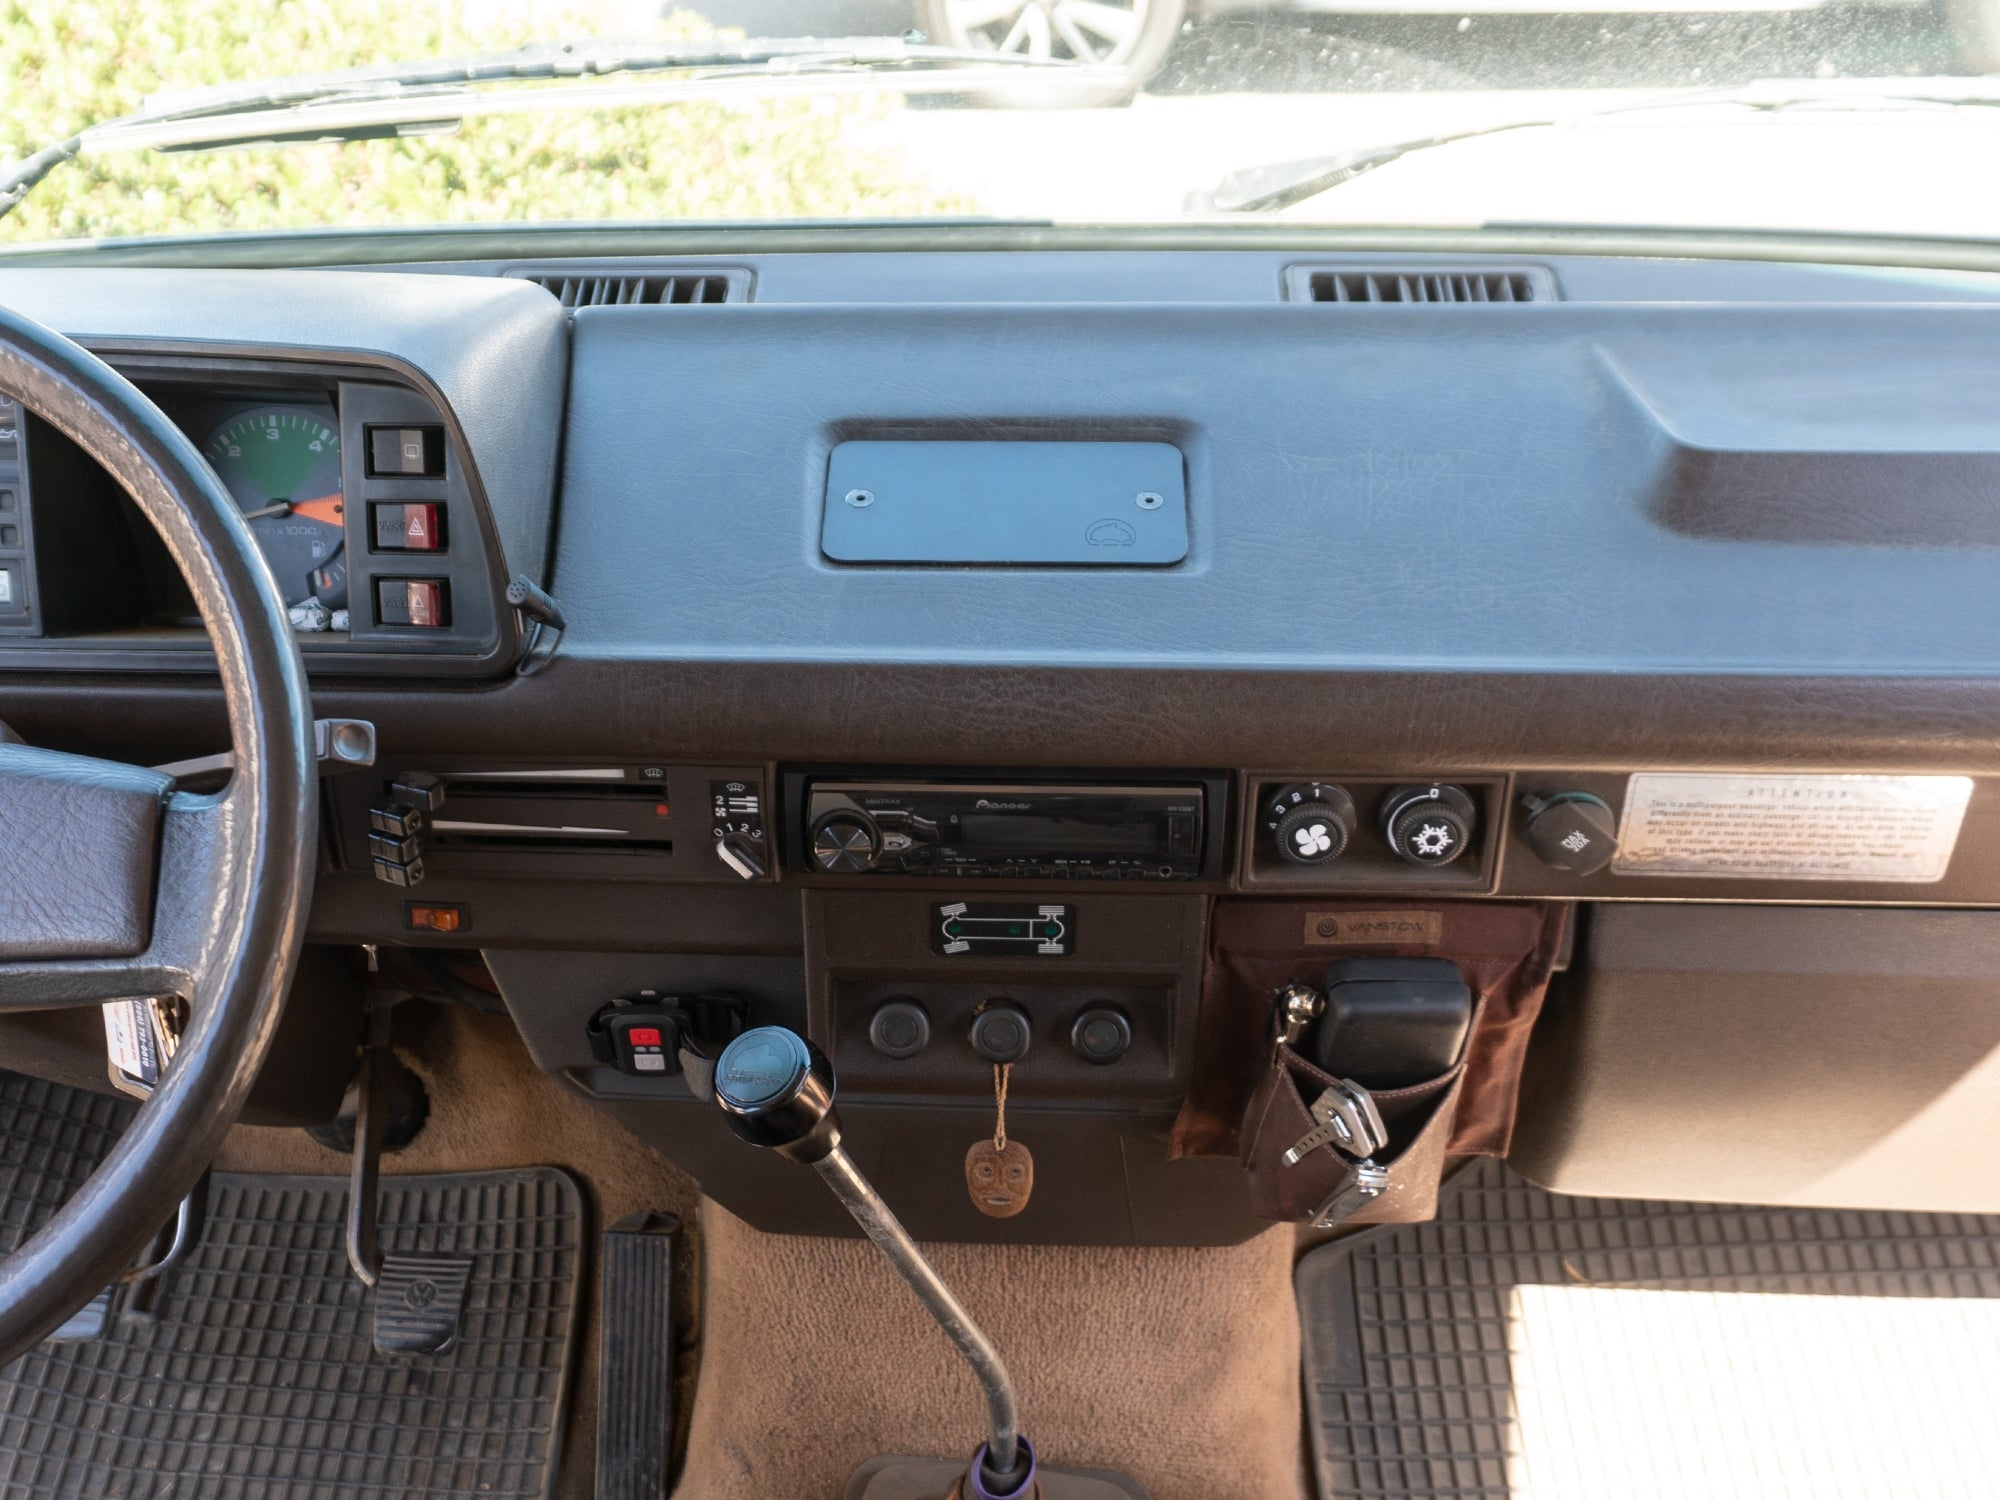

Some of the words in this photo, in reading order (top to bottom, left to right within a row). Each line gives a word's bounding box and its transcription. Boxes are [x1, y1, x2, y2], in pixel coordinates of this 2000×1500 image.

[266, 429, 280, 440] 3
[228, 446, 242, 458] 2
[308, 440, 323, 453] 4
[1747, 787, 1849, 799] ATTENTION
[716, 795, 725, 805] 2
[976, 799, 1032, 810] Pioneer
[1275, 804, 1286, 815] 3
[1291, 792, 1302, 803] 2
[1313, 788, 1321, 798] 1
[1652, 799, 1666, 808] This
[1650, 809, 1691, 818] differently
[713, 828, 724, 838] 0
[726, 822, 734, 832] 1
[740, 823, 750, 833] 2
[751, 829, 763, 839] 3
[1348, 921, 1425, 932] VANSTOW
